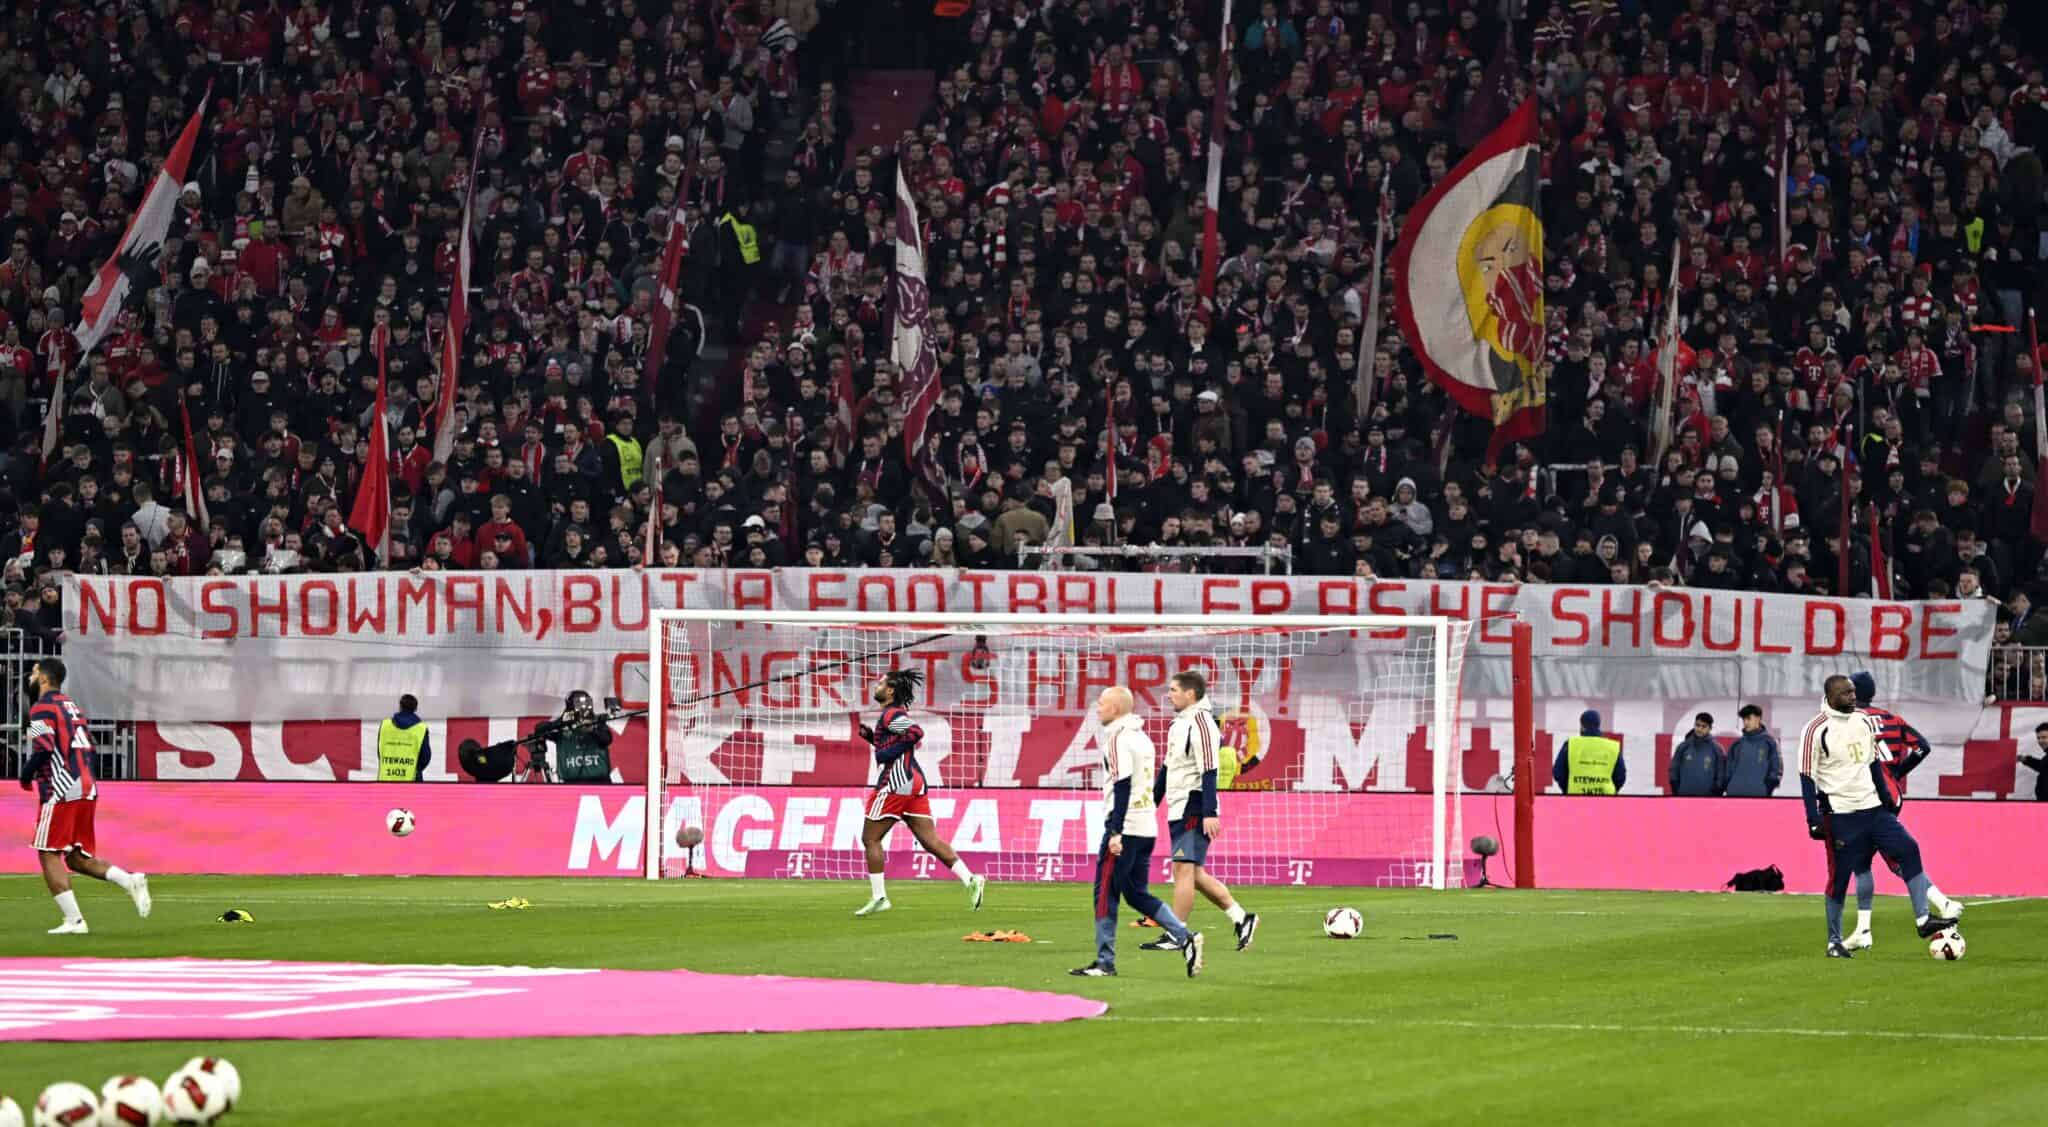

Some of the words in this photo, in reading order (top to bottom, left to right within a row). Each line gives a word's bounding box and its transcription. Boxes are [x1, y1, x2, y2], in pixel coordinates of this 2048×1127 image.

[79, 579, 167, 636] NO
[733, 572, 773, 630] A
[808, 573, 1292, 637] FOOTBALLER
[1318, 581, 1407, 639] AS
[1430, 583, 1520, 643] HE
[1551, 588, 1846, 656] SHOULD
[1869, 604, 1962, 660] BE
[614, 650, 999, 710] CONGRATS
[566, 755, 600, 768] HOST
[1028, 799, 1105, 855] T
